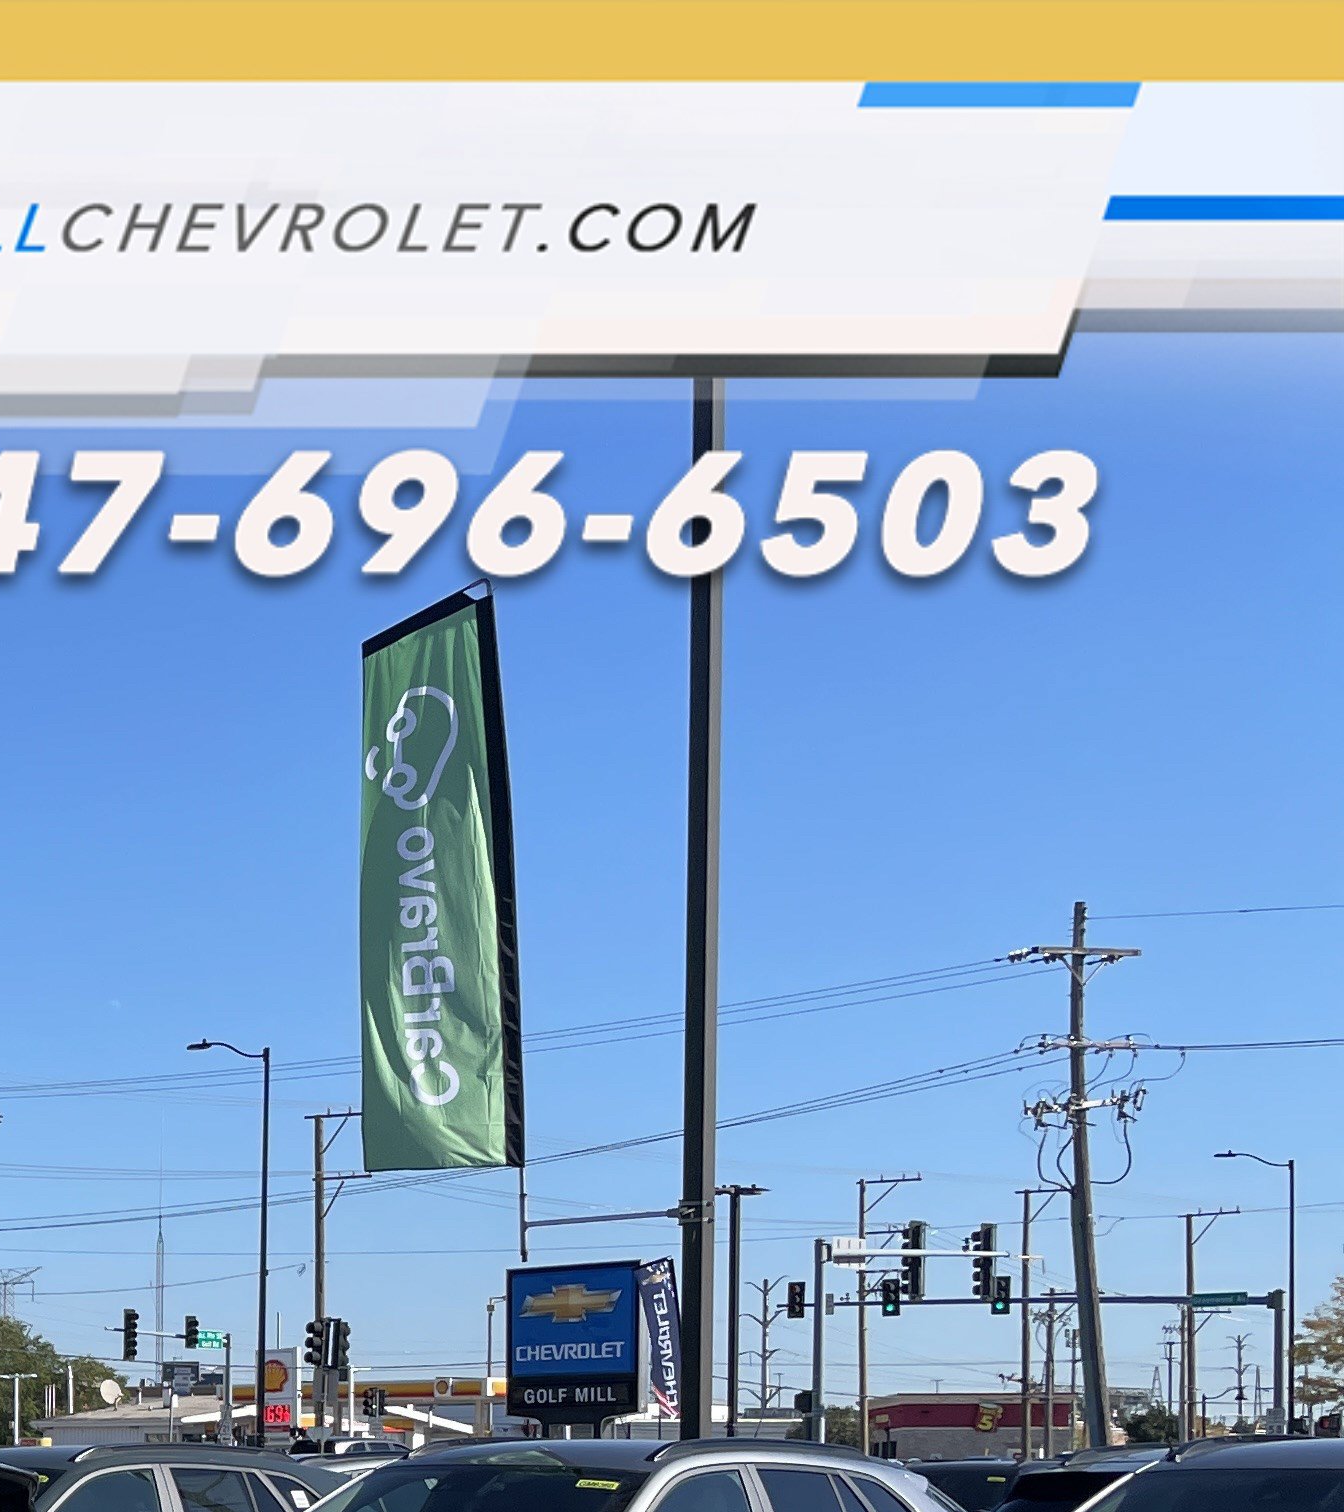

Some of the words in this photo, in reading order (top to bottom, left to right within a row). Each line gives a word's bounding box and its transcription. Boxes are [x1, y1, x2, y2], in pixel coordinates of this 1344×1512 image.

[515, 1341, 625, 1362] CHEVROLET
[524, 1388, 568, 1404] GOLF
[575, 1387, 617, 1402] MILL
